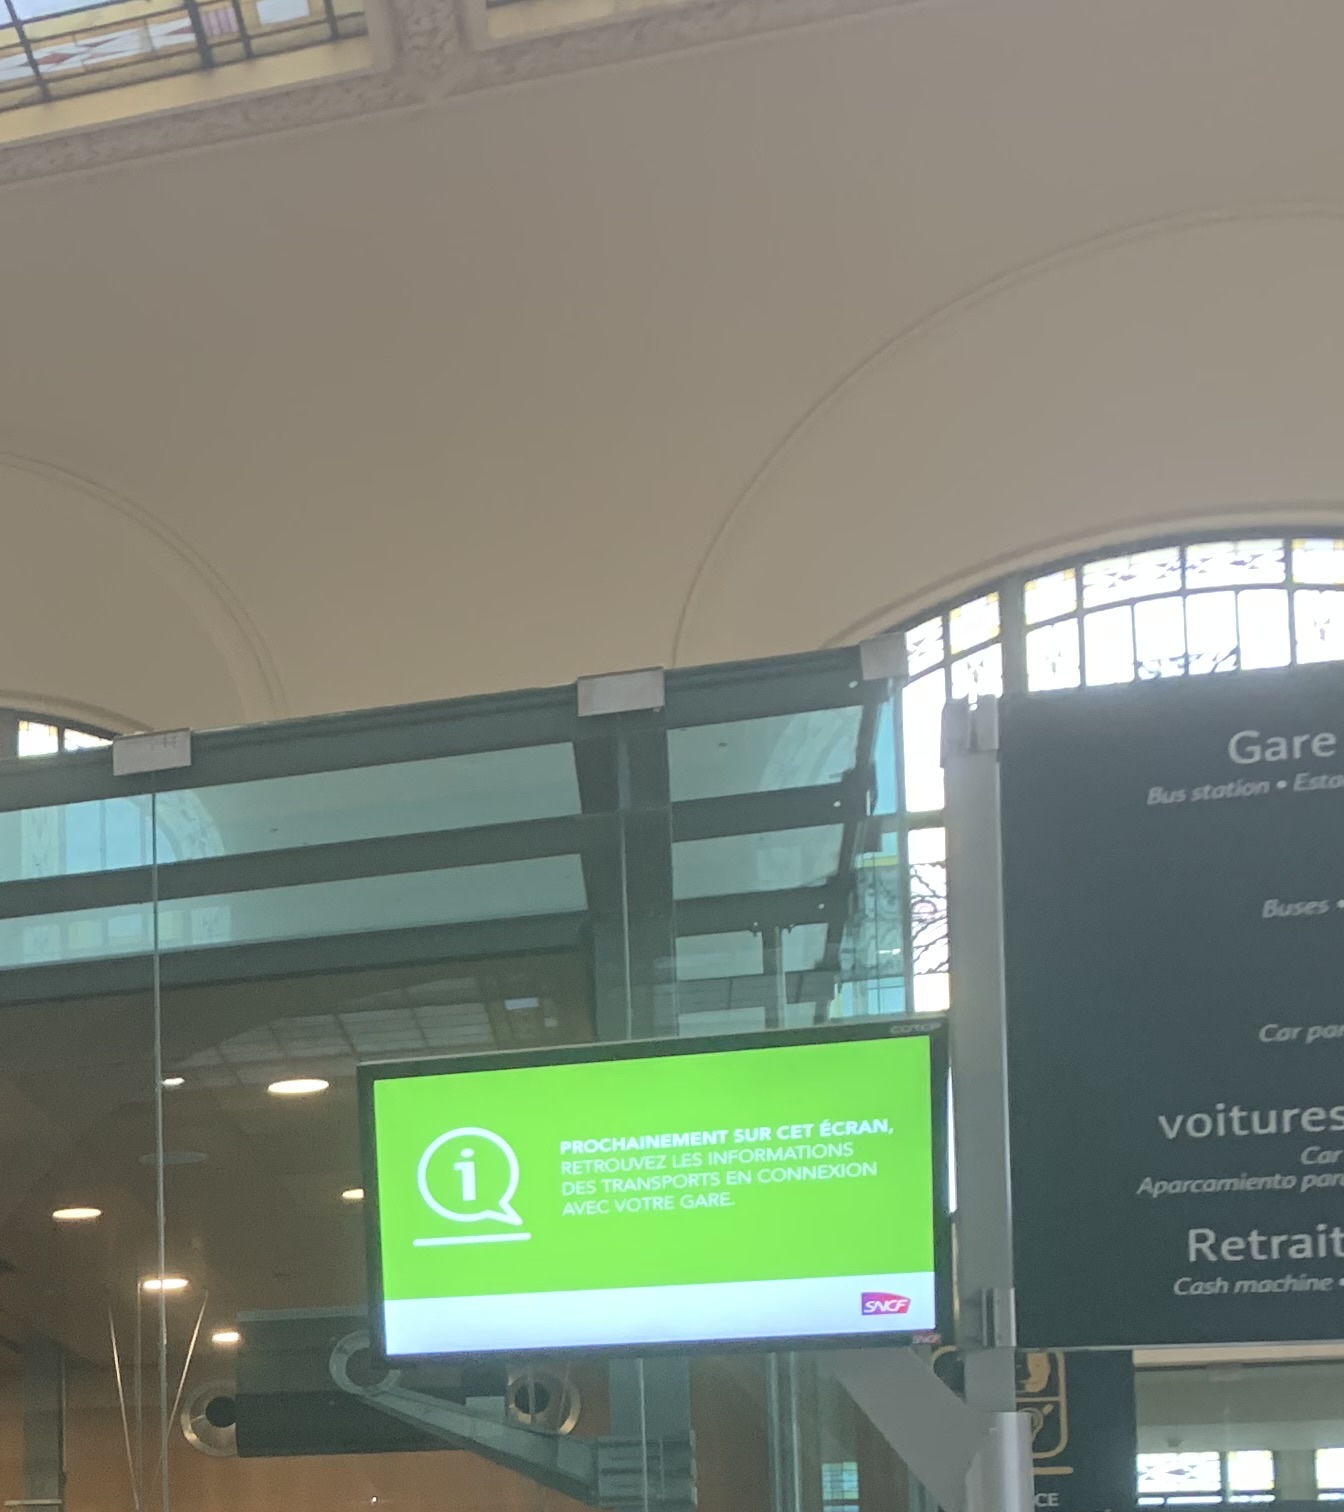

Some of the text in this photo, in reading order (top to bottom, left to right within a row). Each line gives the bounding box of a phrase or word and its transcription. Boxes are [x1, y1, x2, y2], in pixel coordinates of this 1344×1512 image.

[1228, 730, 1337, 764] Gare
[1146, 786, 1186, 806] Bus
[1190, 779, 1270, 802] station
[1262, 899, 1330, 919] Buses
[1259, 1024, 1302, 1043] Car
[1157, 1103, 1344, 1140] voitures
[560, 1118, 894, 1155] PROCHAINEMENT SUR CET ÉCRAN,
[561, 1142, 854, 1175] RETROUVEZ LES INFORMATIONS
[1300, 1146, 1343, 1165] Car
[562, 1161, 878, 1196] DES TRANSPORTS EN CONNEXION
[1137, 1173, 1297, 1198] Aparcamiento
[562, 1191, 736, 1217] AVEC VOTRE GARE.
[1187, 1223, 1344, 1263] Retrait
[1173, 1273, 1334, 1296] Cash machine
[863, 1300, 909, 1313] SNCF
